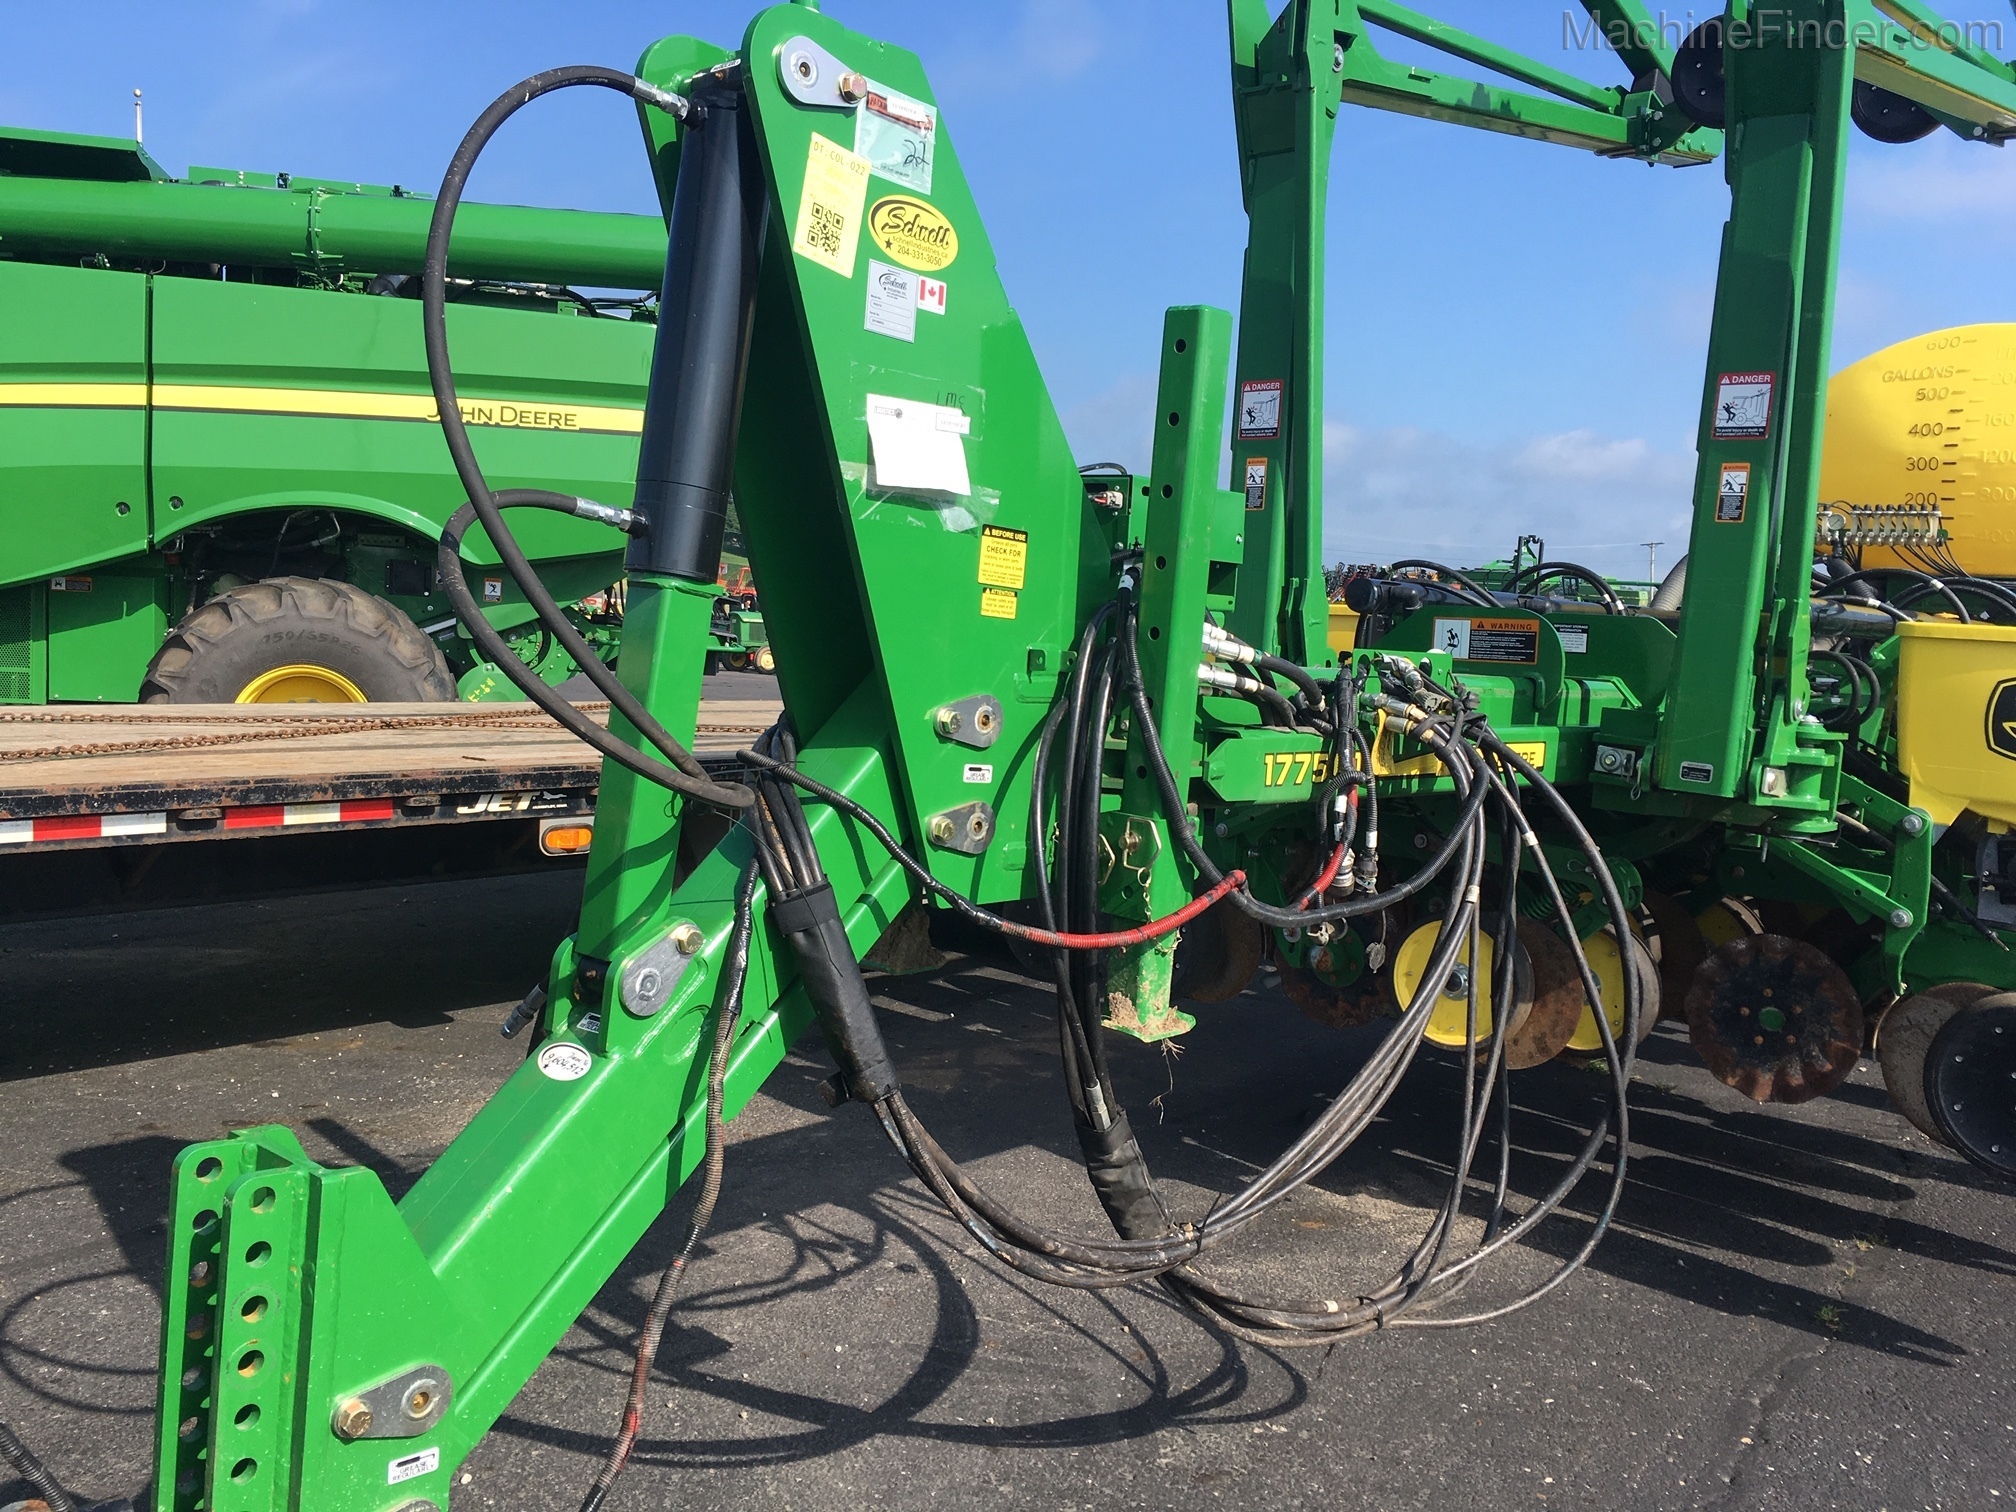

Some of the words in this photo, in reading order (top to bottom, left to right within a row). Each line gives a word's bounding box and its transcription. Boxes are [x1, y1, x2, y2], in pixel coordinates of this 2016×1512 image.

[881, 206, 951, 250] Schnell
[897, 244, 942, 267] 204-331-3050
[1926, 336, 1961, 351] 600
[1731, 374, 1771, 384] DANGER
[1882, 366, 1955, 383] GALLONS
[1251, 382, 1281, 391] DANGER
[1916, 386, 1950, 402] 500
[500, 405, 577, 427] DEERE
[1907, 422, 1944, 437] 400
[1905, 456, 1940, 472] 300
[1905, 492, 1938, 507] 200
[991, 529, 1014, 539] BEFORE
[1015, 533, 1026, 542] USE
[986, 545, 1008, 555] CHECK
[1009, 549, 1021, 557] FOR
[1490, 622, 1532, 631] WARNING
[456, 790, 541, 815] JET
[392, 1464, 435, 1481] REGULARLY
[399, 1460, 427, 1474] GREASE
